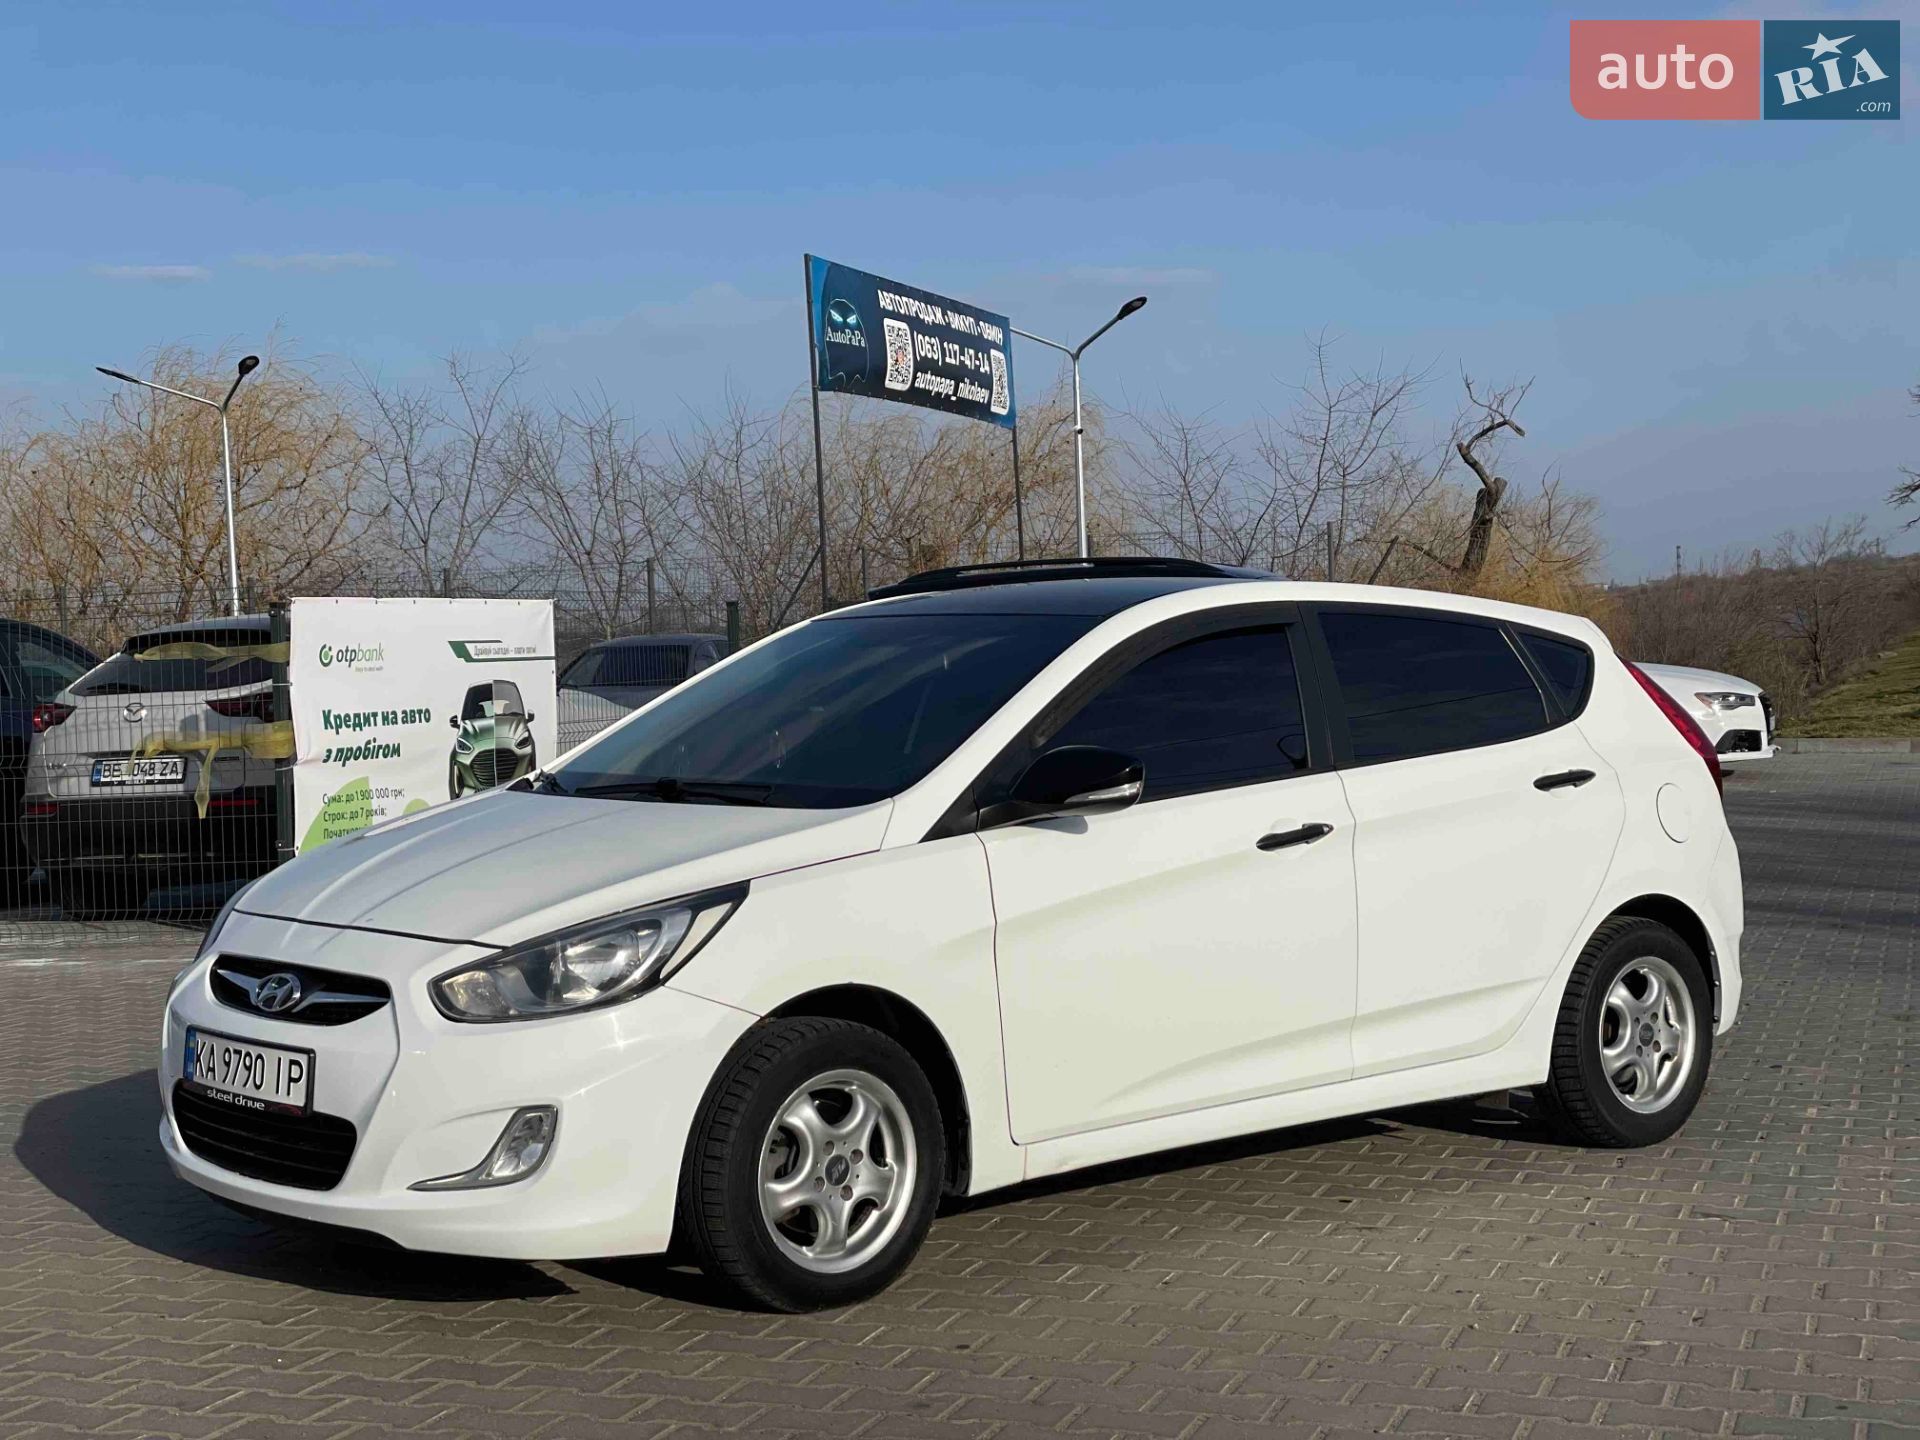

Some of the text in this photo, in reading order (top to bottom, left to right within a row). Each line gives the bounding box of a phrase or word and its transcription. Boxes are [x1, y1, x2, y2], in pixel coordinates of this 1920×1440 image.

[877, 290, 946, 326] АВТОПРОДАЖ
[826, 327, 866, 348] AutoPaPa
[914, 330, 990, 375] (063) 117-47-14
[336, 642, 384, 668] otpbank
[322, 707, 431, 735] Кредит на авто
[322, 737, 401, 768] з пробігом
[102, 763, 121, 778] BE
[159, 761, 179, 777] ZA
[322, 793, 344, 807] Сума:
[345, 794, 355, 805] до
[323, 805, 387, 824] Строк: до 7 років;
[195, 1039, 305, 1098] KA 9790 IP
[207, 1088, 265, 1111] steel drive
